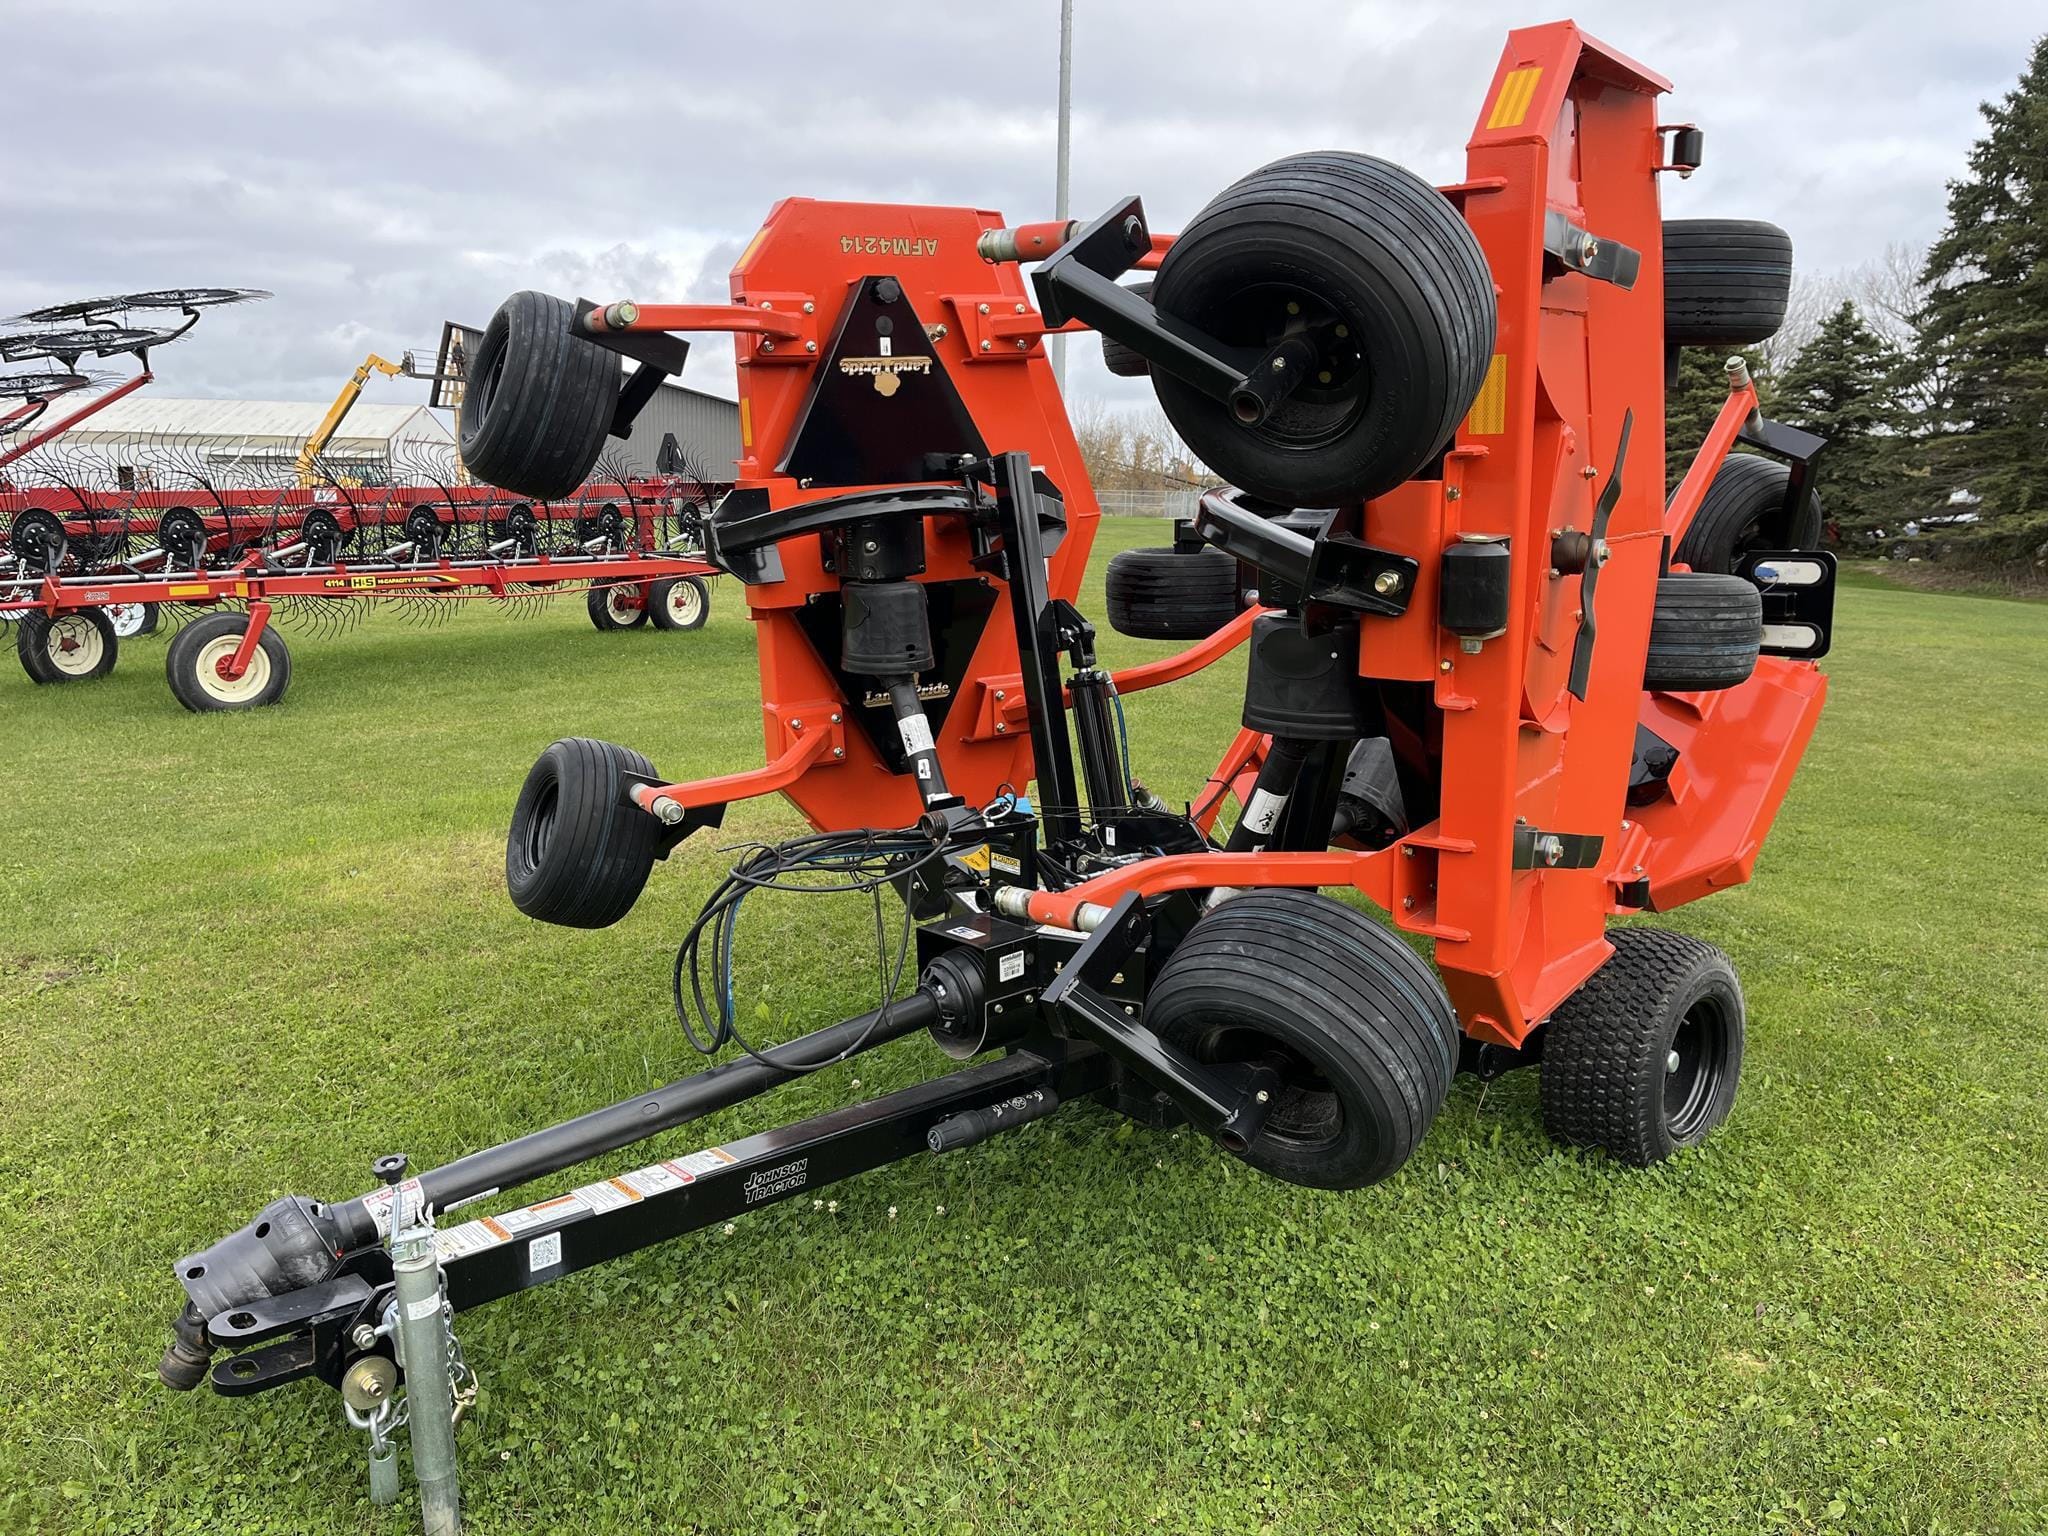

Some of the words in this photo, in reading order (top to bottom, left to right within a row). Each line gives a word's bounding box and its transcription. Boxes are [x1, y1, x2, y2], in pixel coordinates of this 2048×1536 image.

[840, 235, 938, 256] AFM4214
[841, 360, 880, 376] Pride
[893, 359, 931, 375] Land
[325, 579, 345, 587] 4114
[865, 690, 891, 703] Lan
[744, 1158, 808, 1190] JOHNSON
[745, 1172, 807, 1204] TRACTOR
